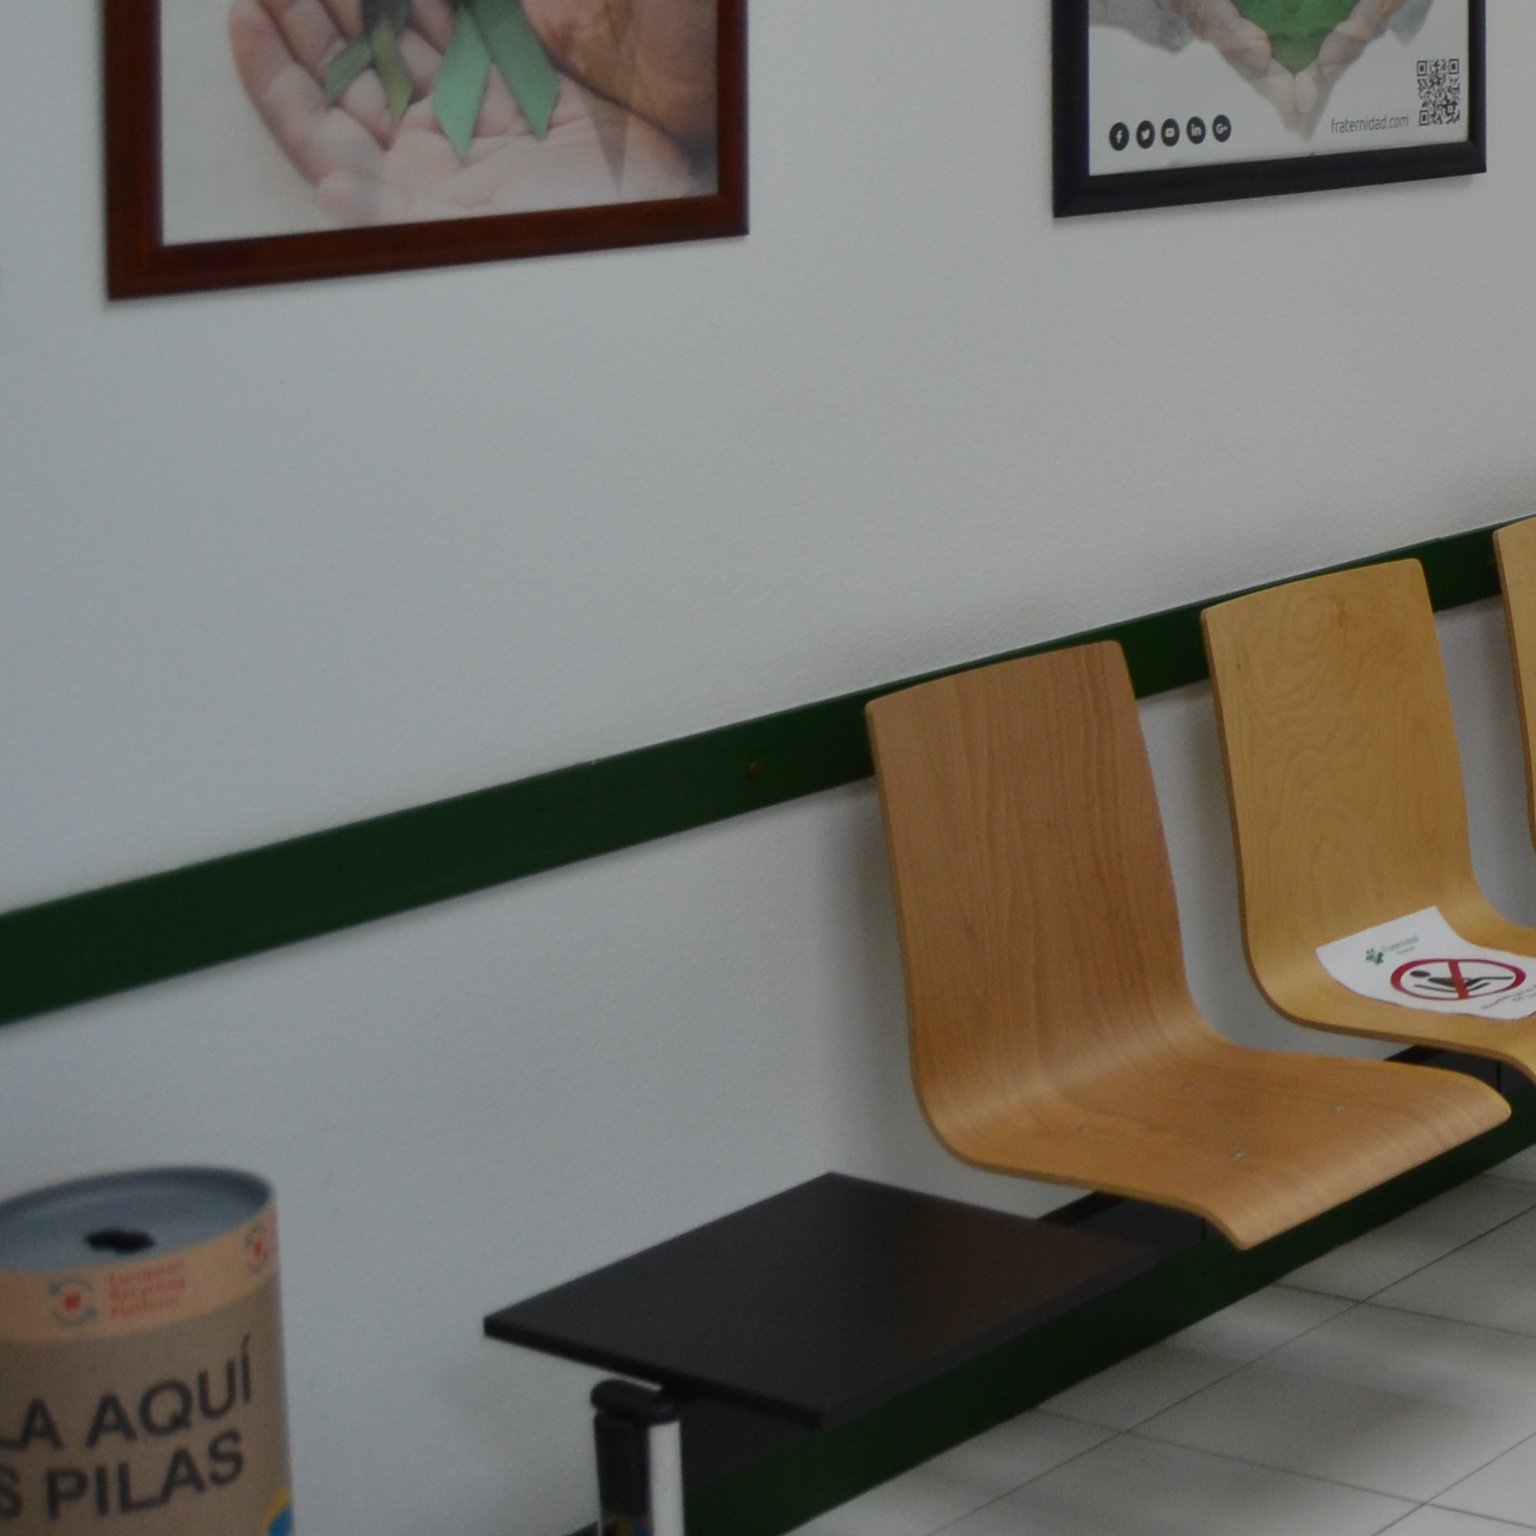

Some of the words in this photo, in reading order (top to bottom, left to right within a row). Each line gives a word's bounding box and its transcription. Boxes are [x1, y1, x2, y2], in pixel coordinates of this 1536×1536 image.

[1330, 116, 1410, 135] fraternidad.com
[87, 1333, 252, 1449] AQUÍ
[46, 1429, 244, 1521] PILAS
